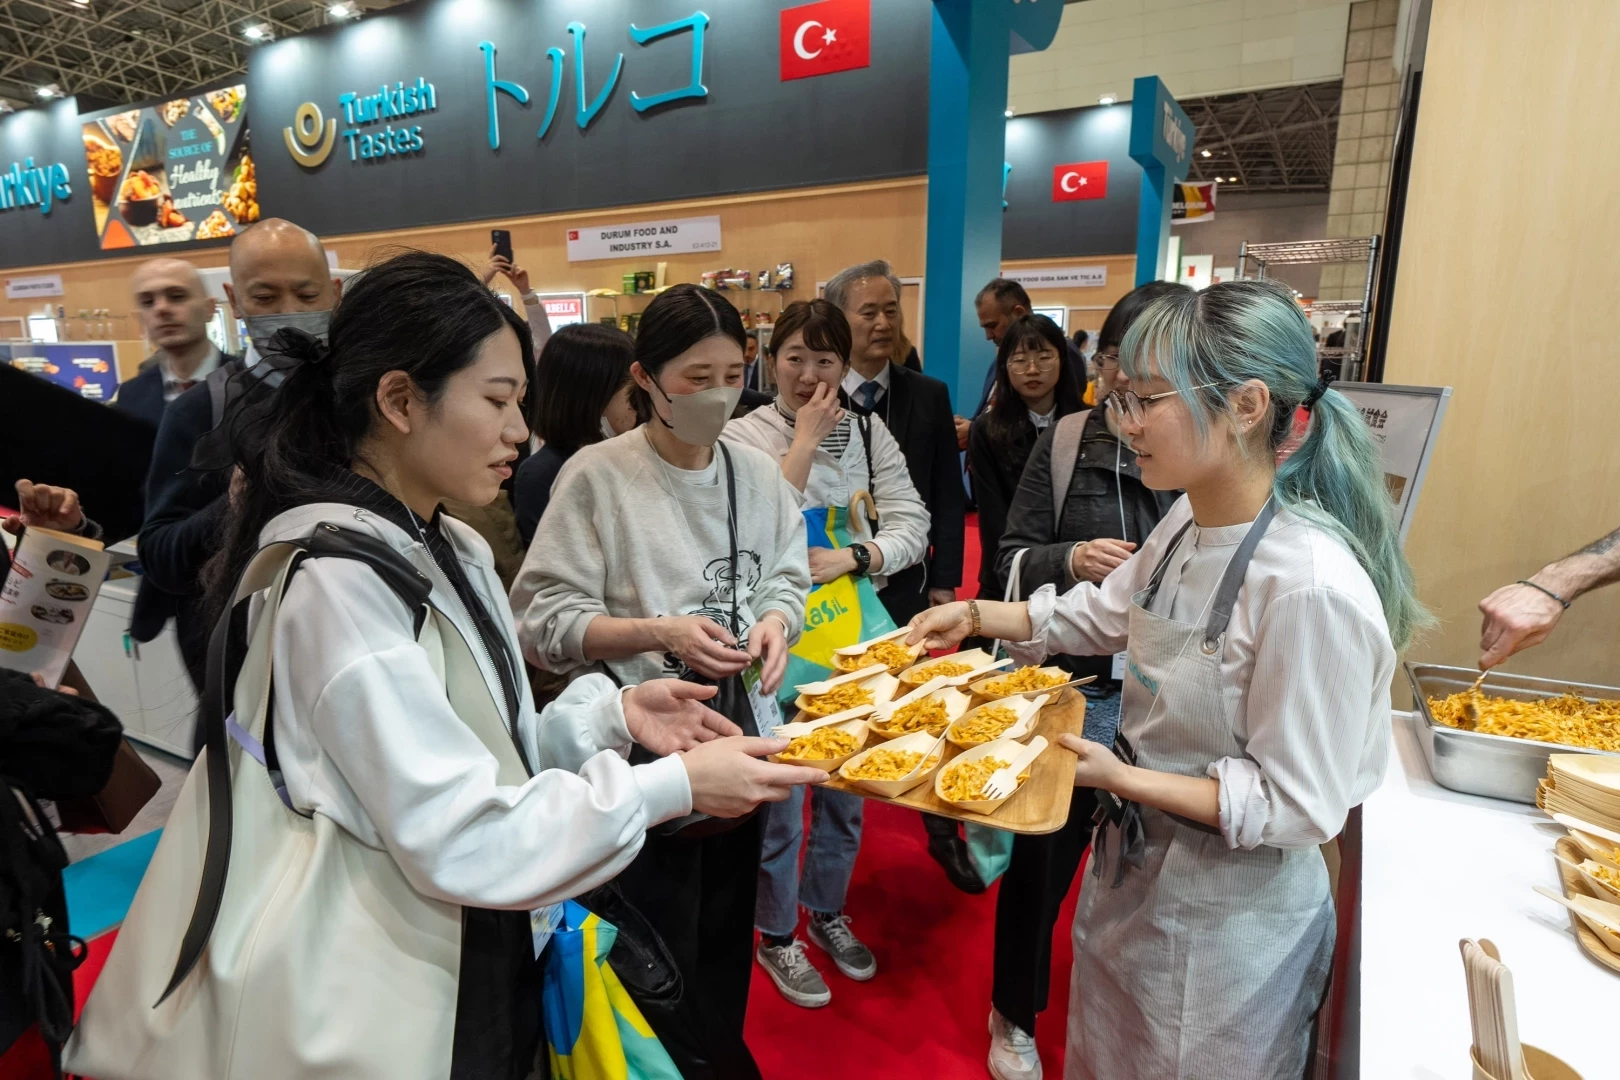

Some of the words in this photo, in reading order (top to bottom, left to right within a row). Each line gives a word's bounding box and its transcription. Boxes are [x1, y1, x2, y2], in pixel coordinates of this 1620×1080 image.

[478, 11, 710, 150] トルコ
[339, 77, 436, 124] Turkish
[181, 129, 197, 141] THE
[342, 125, 423, 160] Tastes
[168, 144, 200, 159] SOURCE
[201, 141, 213, 153] OF
[170, 159, 219, 190] Healthy
[173, 190, 223, 209] nutrients
[601, 231, 631, 240] DURUM
[634, 228, 657, 237] FOOD
[660, 225, 678, 235] AND
[609, 241, 653, 252] INDUSTRY
[655, 239, 672, 249] S.A.
